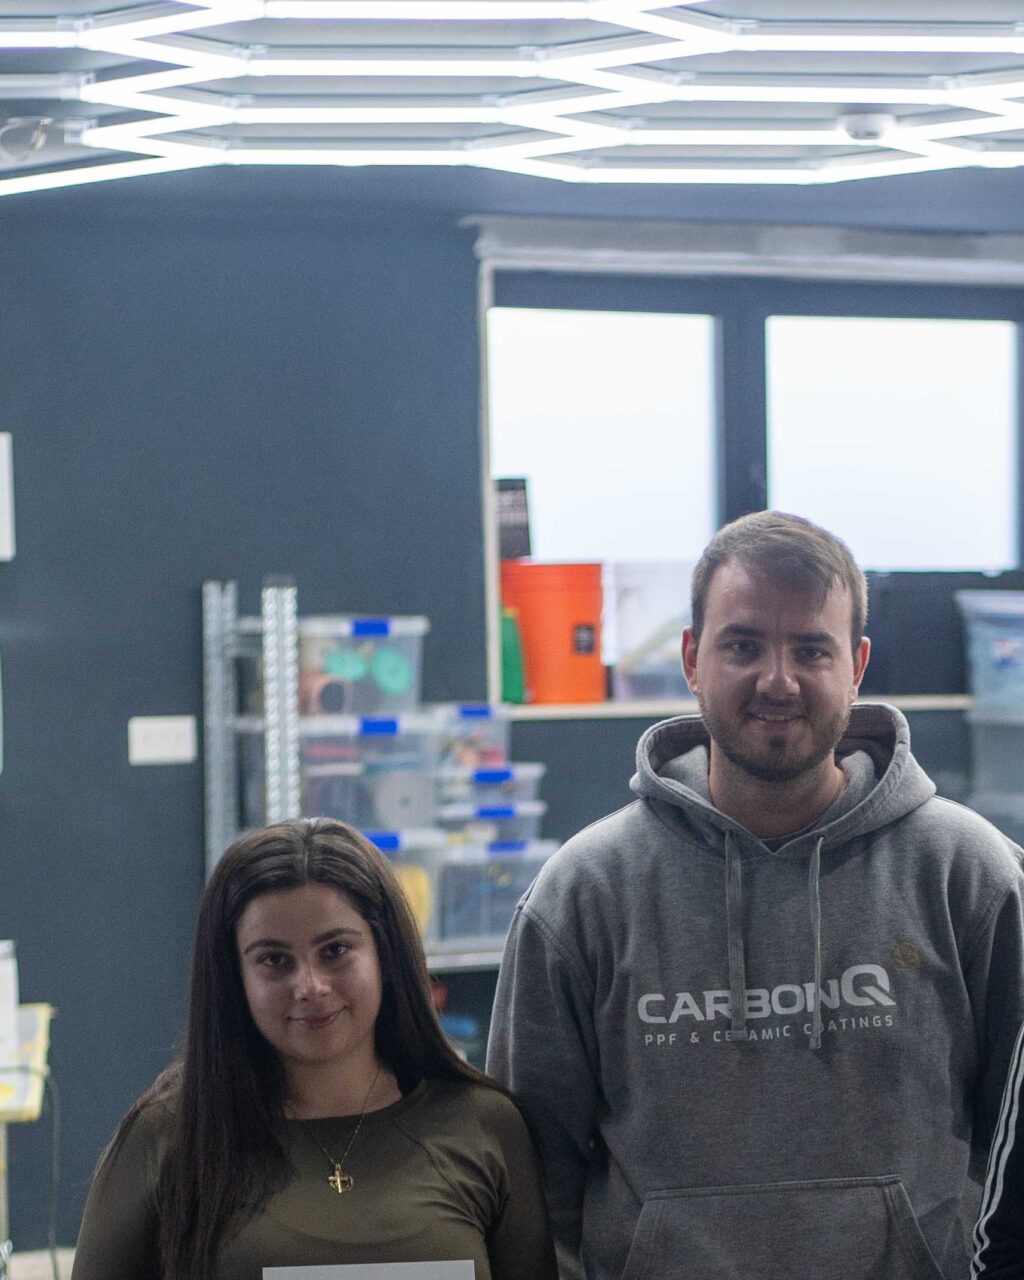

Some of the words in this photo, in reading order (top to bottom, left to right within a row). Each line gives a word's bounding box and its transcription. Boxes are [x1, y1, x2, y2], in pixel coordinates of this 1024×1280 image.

[637, 964, 897, 1024] CARBONQ
[645, 1033, 677, 1046] PPF
[690, 1031, 700, 1043] &
[713, 1024, 791, 1043] CEAMIC
